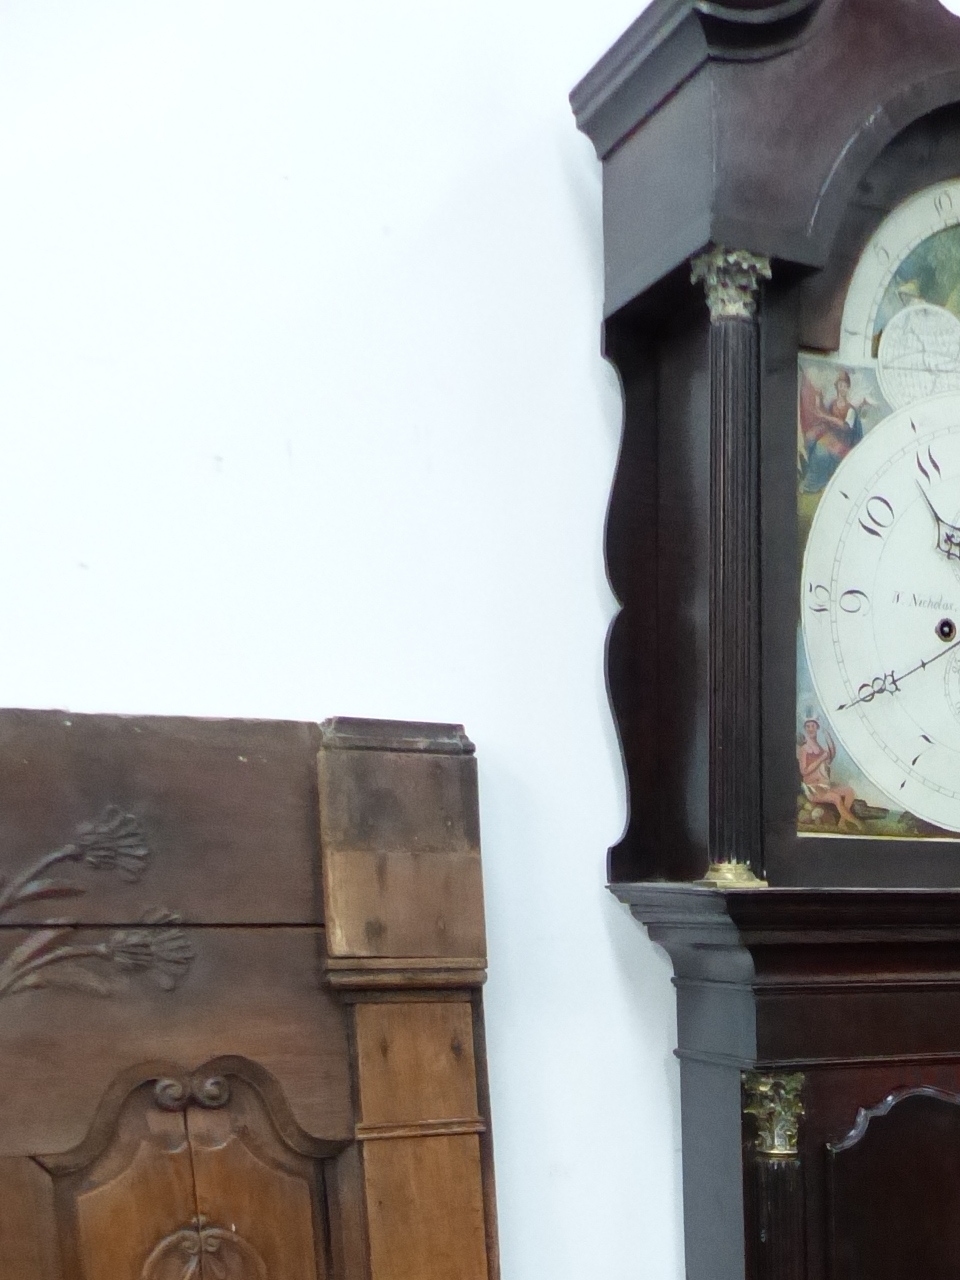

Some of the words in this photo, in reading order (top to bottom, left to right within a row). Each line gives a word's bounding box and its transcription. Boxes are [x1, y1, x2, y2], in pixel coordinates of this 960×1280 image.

[916, 444, 942, 486] 11
[858, 495, 895, 541] 10
[839, 589, 871, 617] 9
